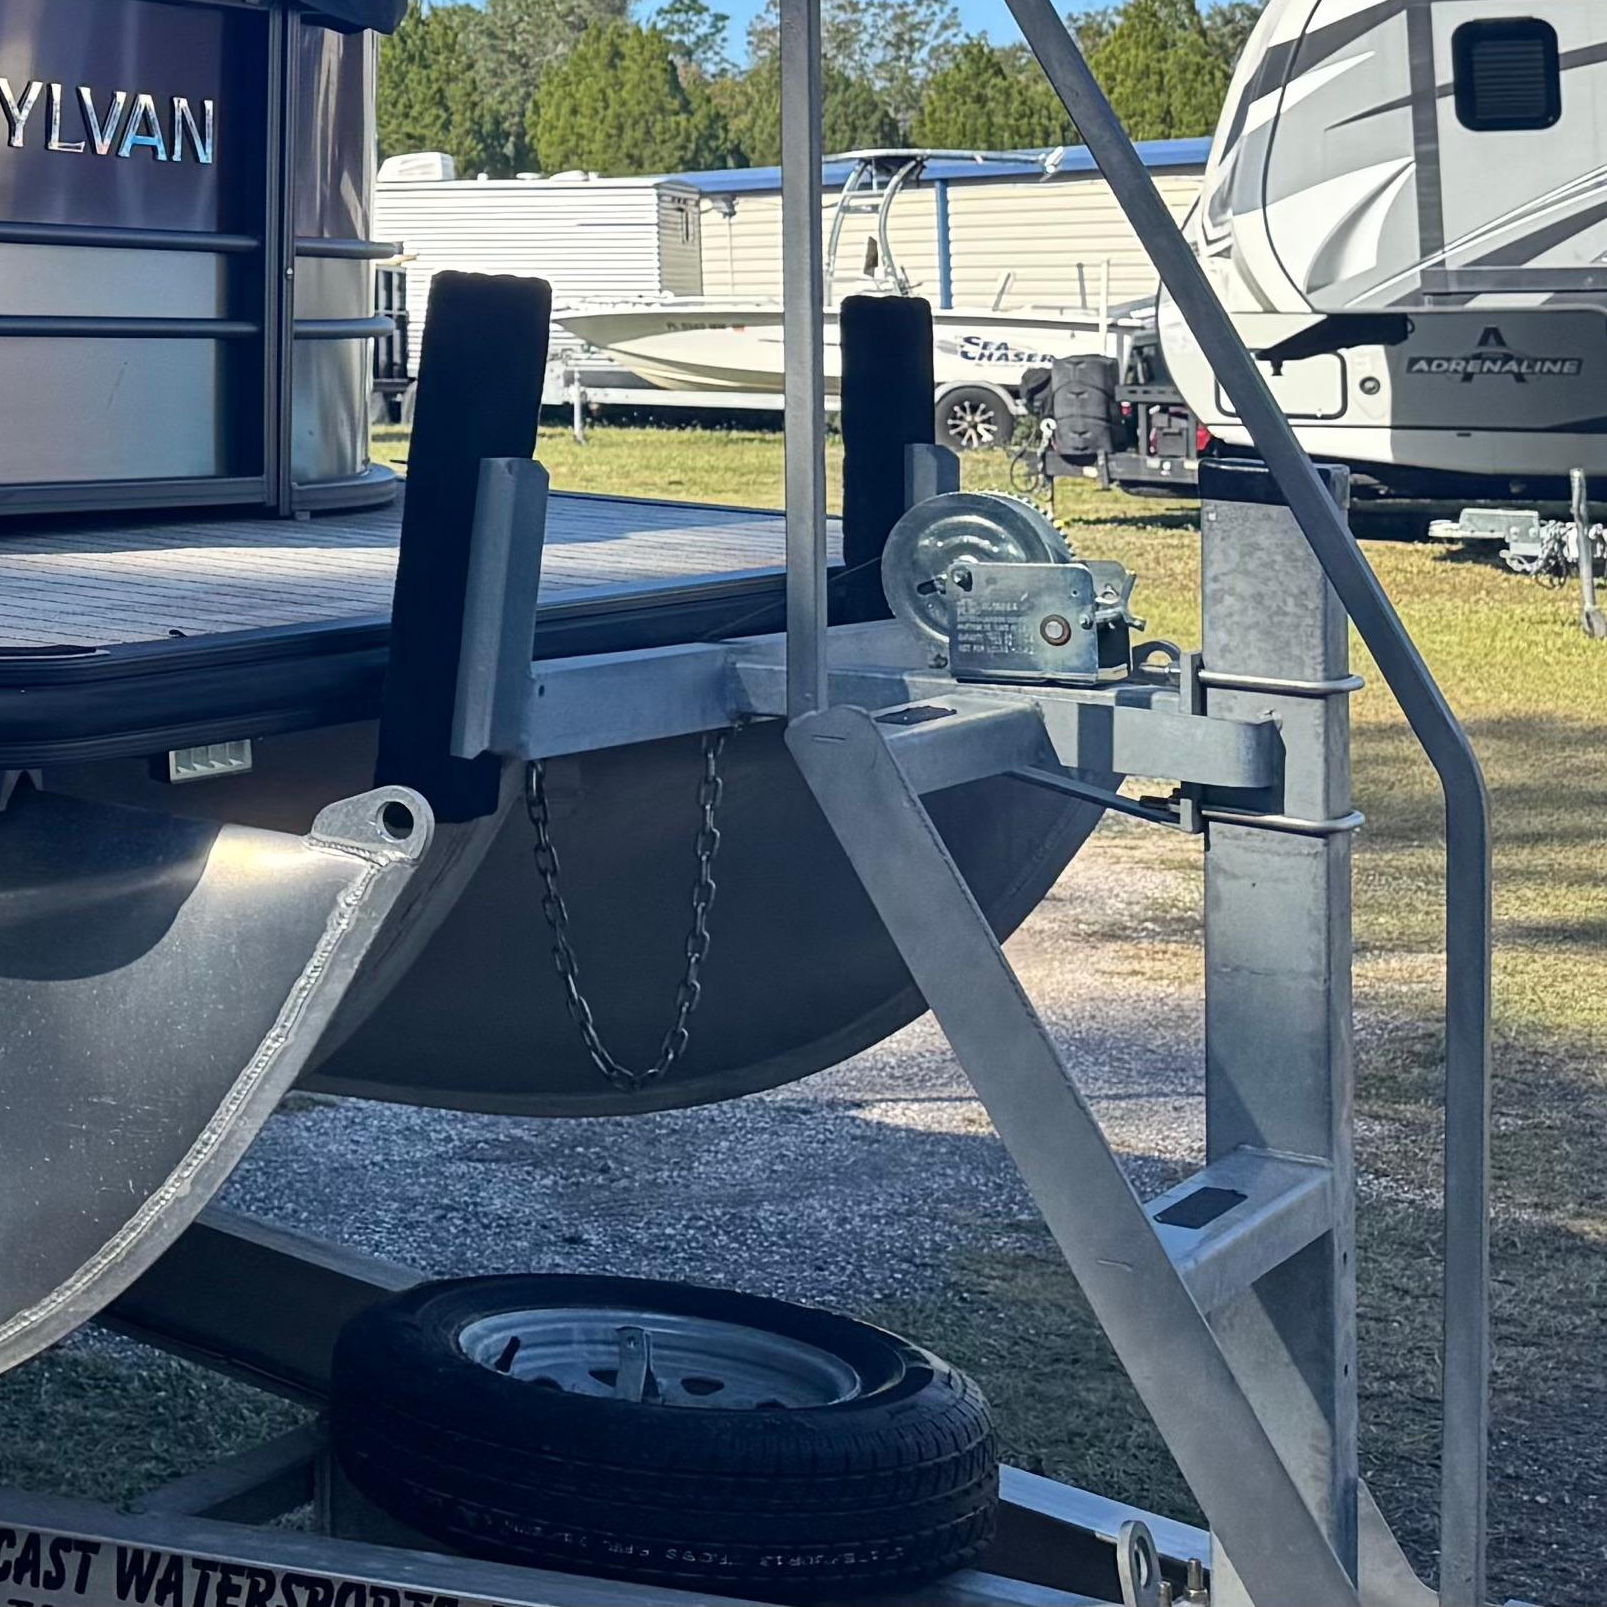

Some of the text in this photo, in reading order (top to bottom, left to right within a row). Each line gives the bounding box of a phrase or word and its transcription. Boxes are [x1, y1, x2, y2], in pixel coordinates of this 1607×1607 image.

[962, 336, 1009, 351] SEA
[960, 350, 1055, 363] CHASER
[1410, 358, 1580, 374] ADRENALINE
[116, 1545, 458, 1607] WATERSP
